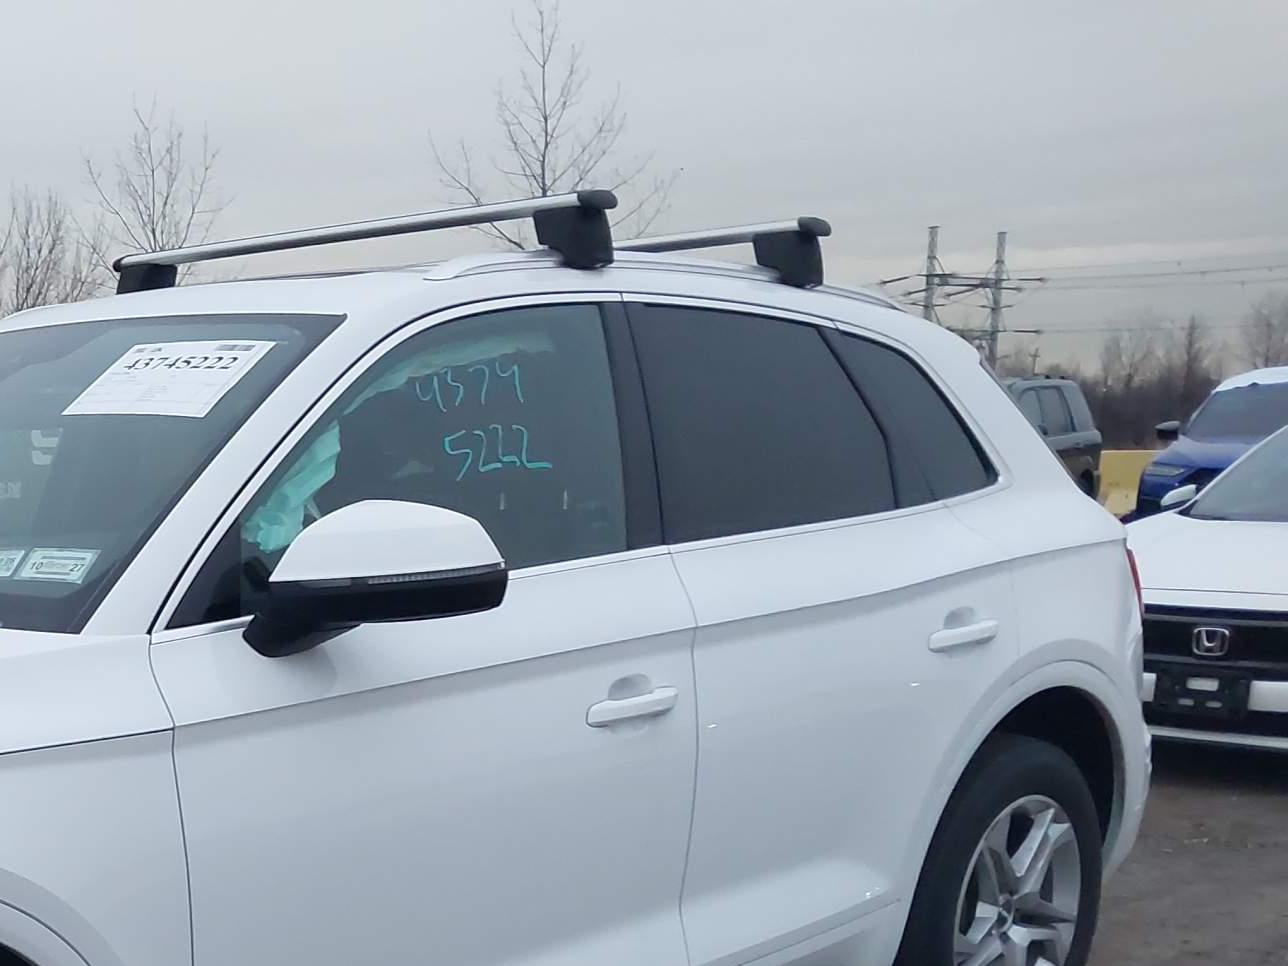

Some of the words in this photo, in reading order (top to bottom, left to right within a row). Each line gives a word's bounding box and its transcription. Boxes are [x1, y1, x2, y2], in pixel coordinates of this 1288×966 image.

[123, 356, 239, 371] 43745222
[415, 361, 524, 413] 4374
[443, 424, 553, 481] 5222
[29, 561, 43, 571] 10
[69, 563, 85, 573] 27
